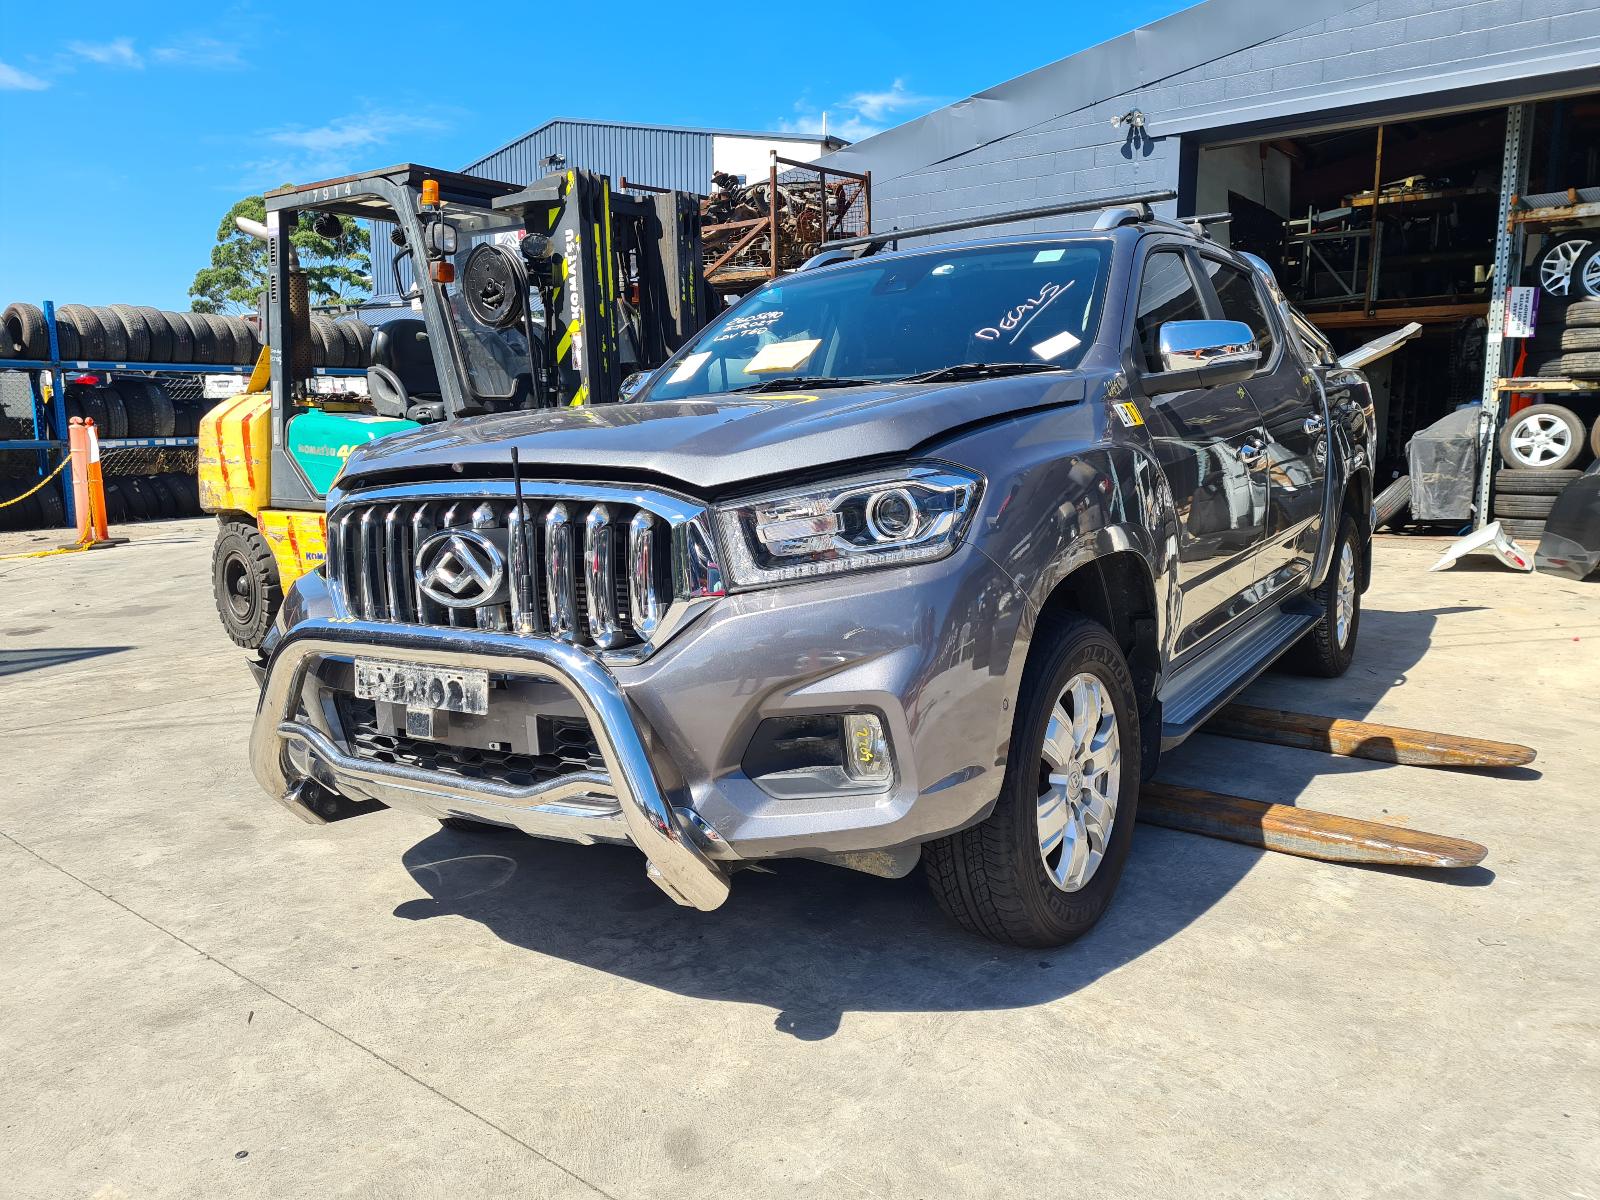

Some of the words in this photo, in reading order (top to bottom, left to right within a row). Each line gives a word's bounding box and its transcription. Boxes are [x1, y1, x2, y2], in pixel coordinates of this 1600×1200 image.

[313, 183, 352, 202] 7914
[564, 229, 580, 320] KOMATSU
[975, 282, 1060, 340] DECALS
[306, 552, 327, 560] KOM
